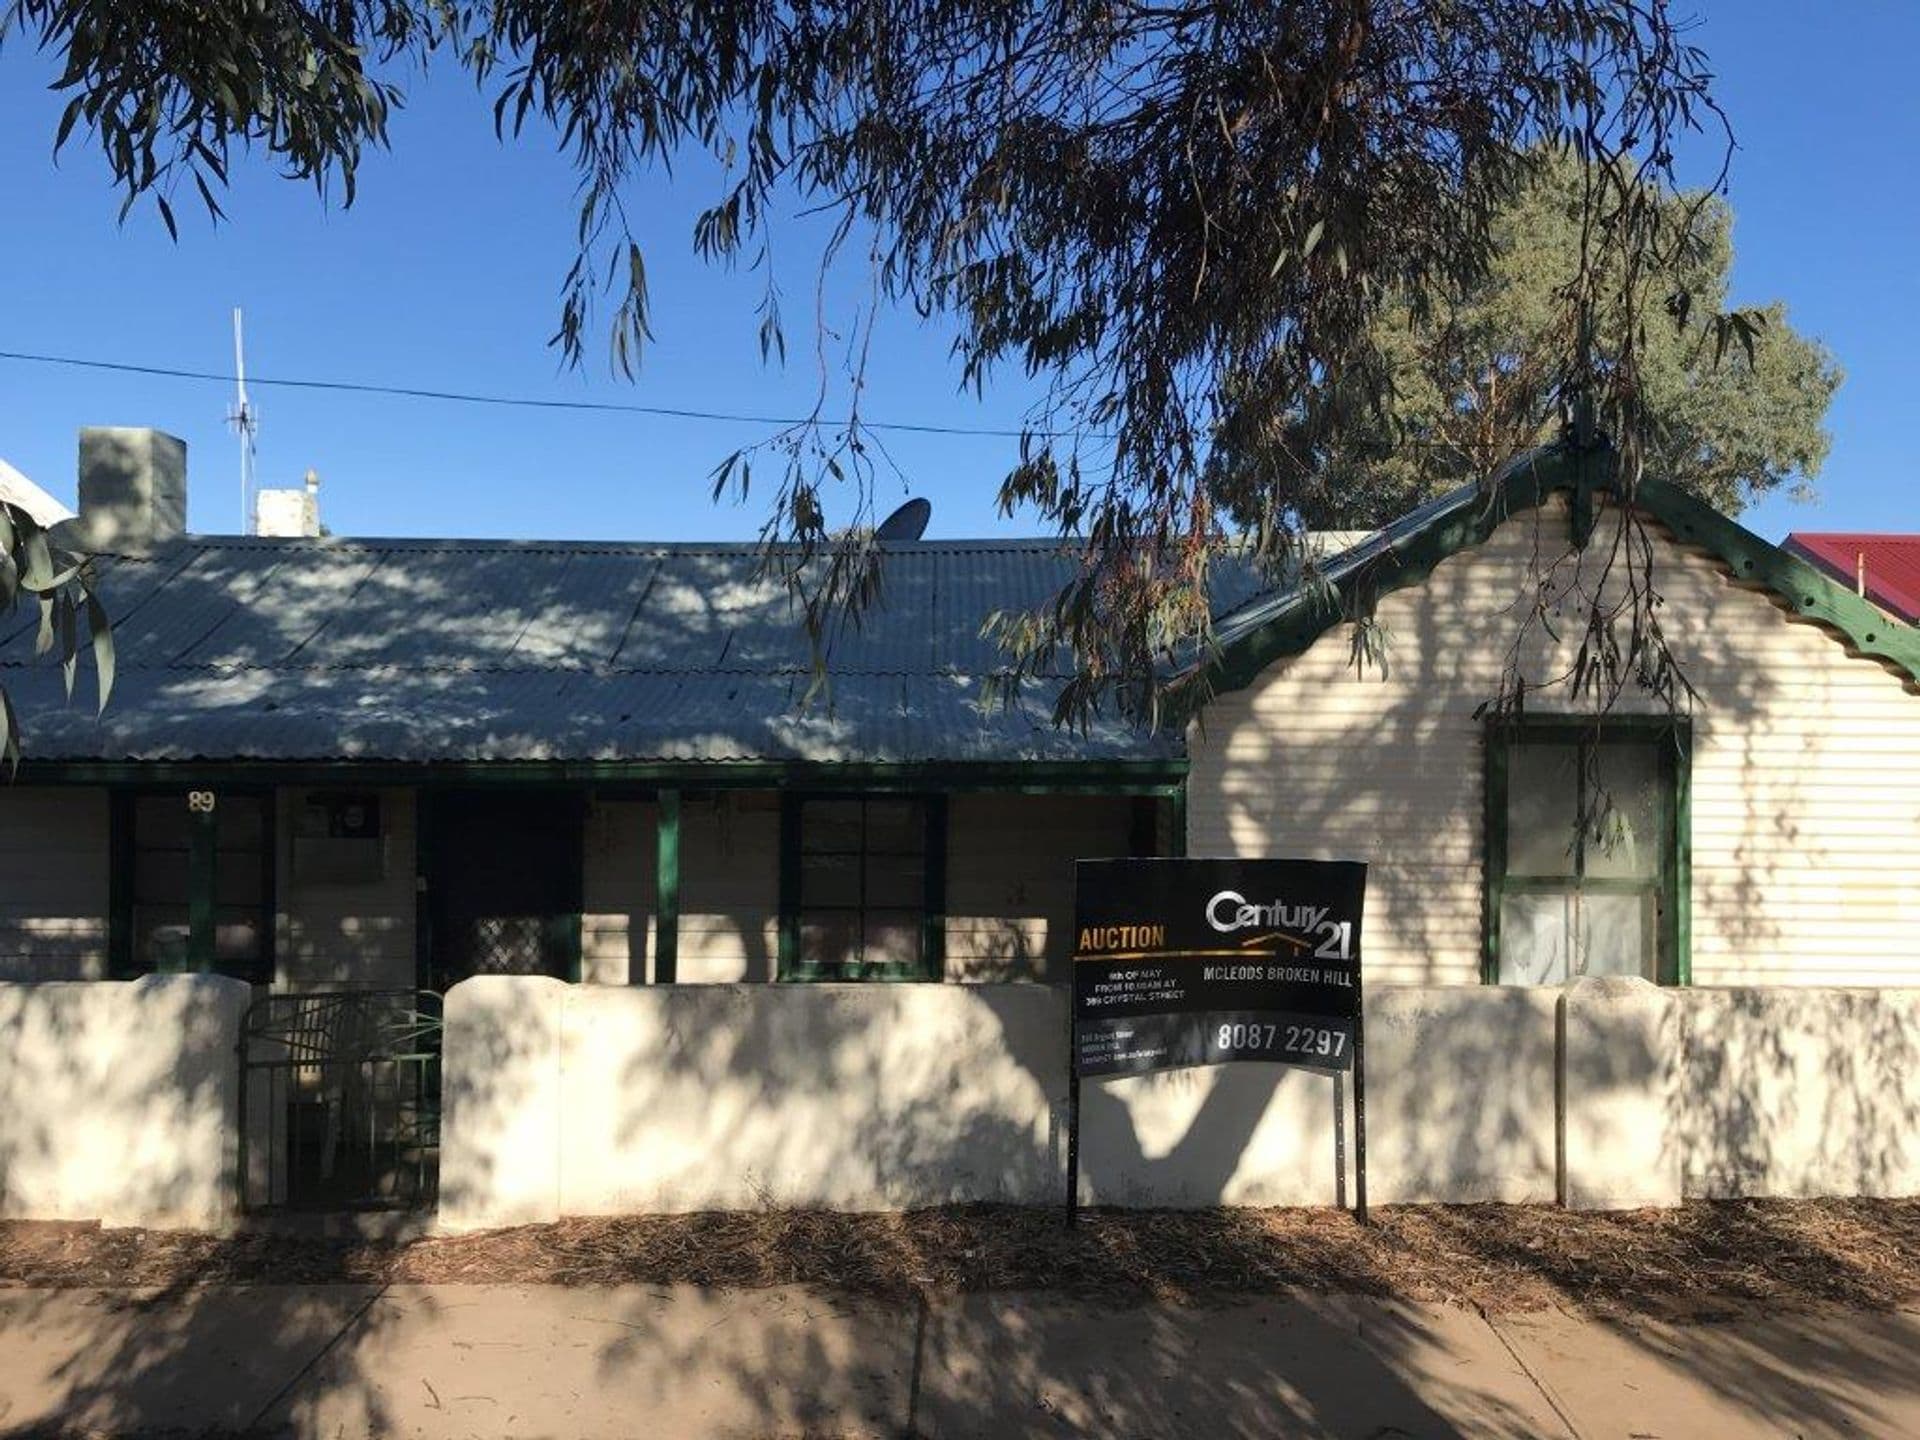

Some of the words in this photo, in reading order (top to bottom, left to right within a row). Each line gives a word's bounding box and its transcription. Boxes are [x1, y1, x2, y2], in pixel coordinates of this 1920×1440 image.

[189, 791, 215, 812] 89
[1206, 890, 1330, 933] Century
[1314, 921, 1352, 960] 21
[1080, 925, 1164, 950] AUCTION
[1203, 966, 1264, 981] MCLEODS
[1267, 967, 1320, 983] BROKEN
[1323, 971, 1353, 988] HILL
[1149, 989, 1185, 1001] STREET
[1218, 1023, 1276, 1050] 8087
[1285, 1025, 1346, 1057] 2297
